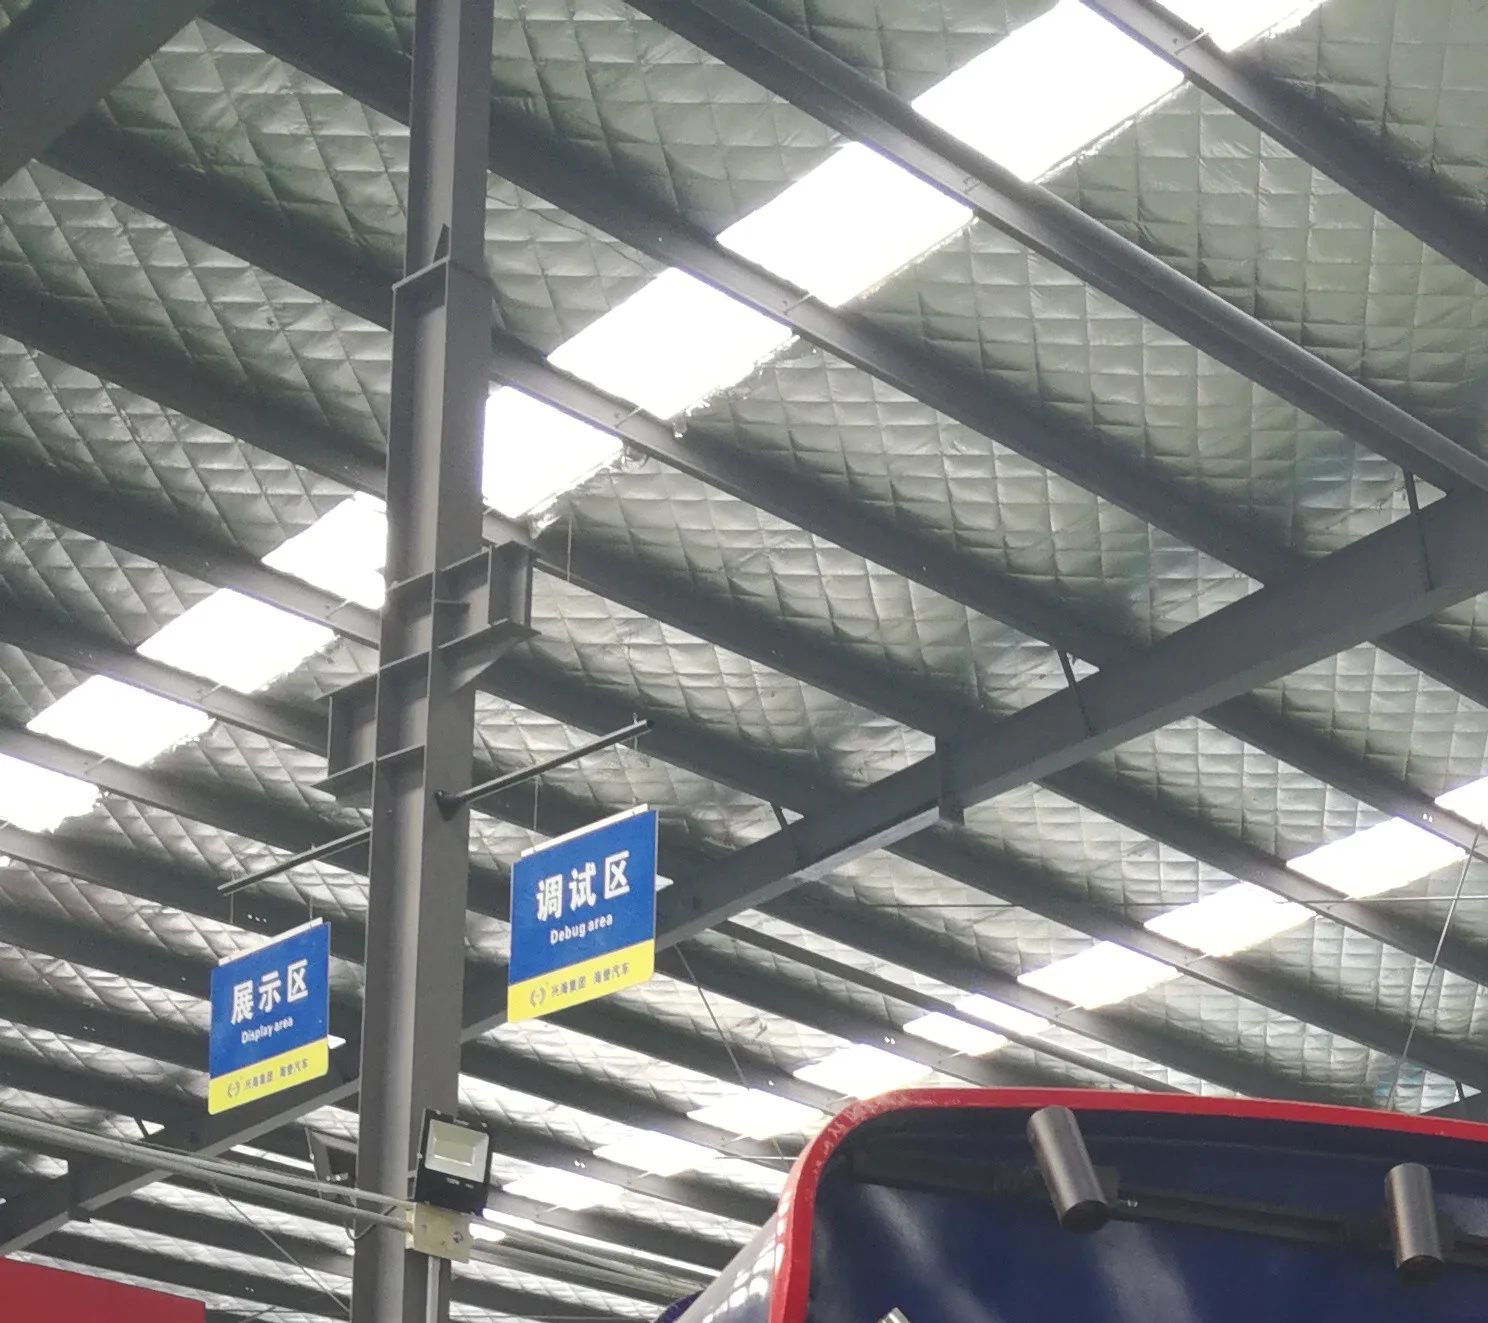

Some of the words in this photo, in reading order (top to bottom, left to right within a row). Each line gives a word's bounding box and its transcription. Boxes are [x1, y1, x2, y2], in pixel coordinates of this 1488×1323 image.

[536, 849, 631, 922] 调试区
[549, 920, 586, 946] Debug
[587, 913, 614, 934] area
[231, 958, 309, 1026] 展示区
[241, 1022, 273, 1045] Display
[273, 1016, 294, 1032] area
